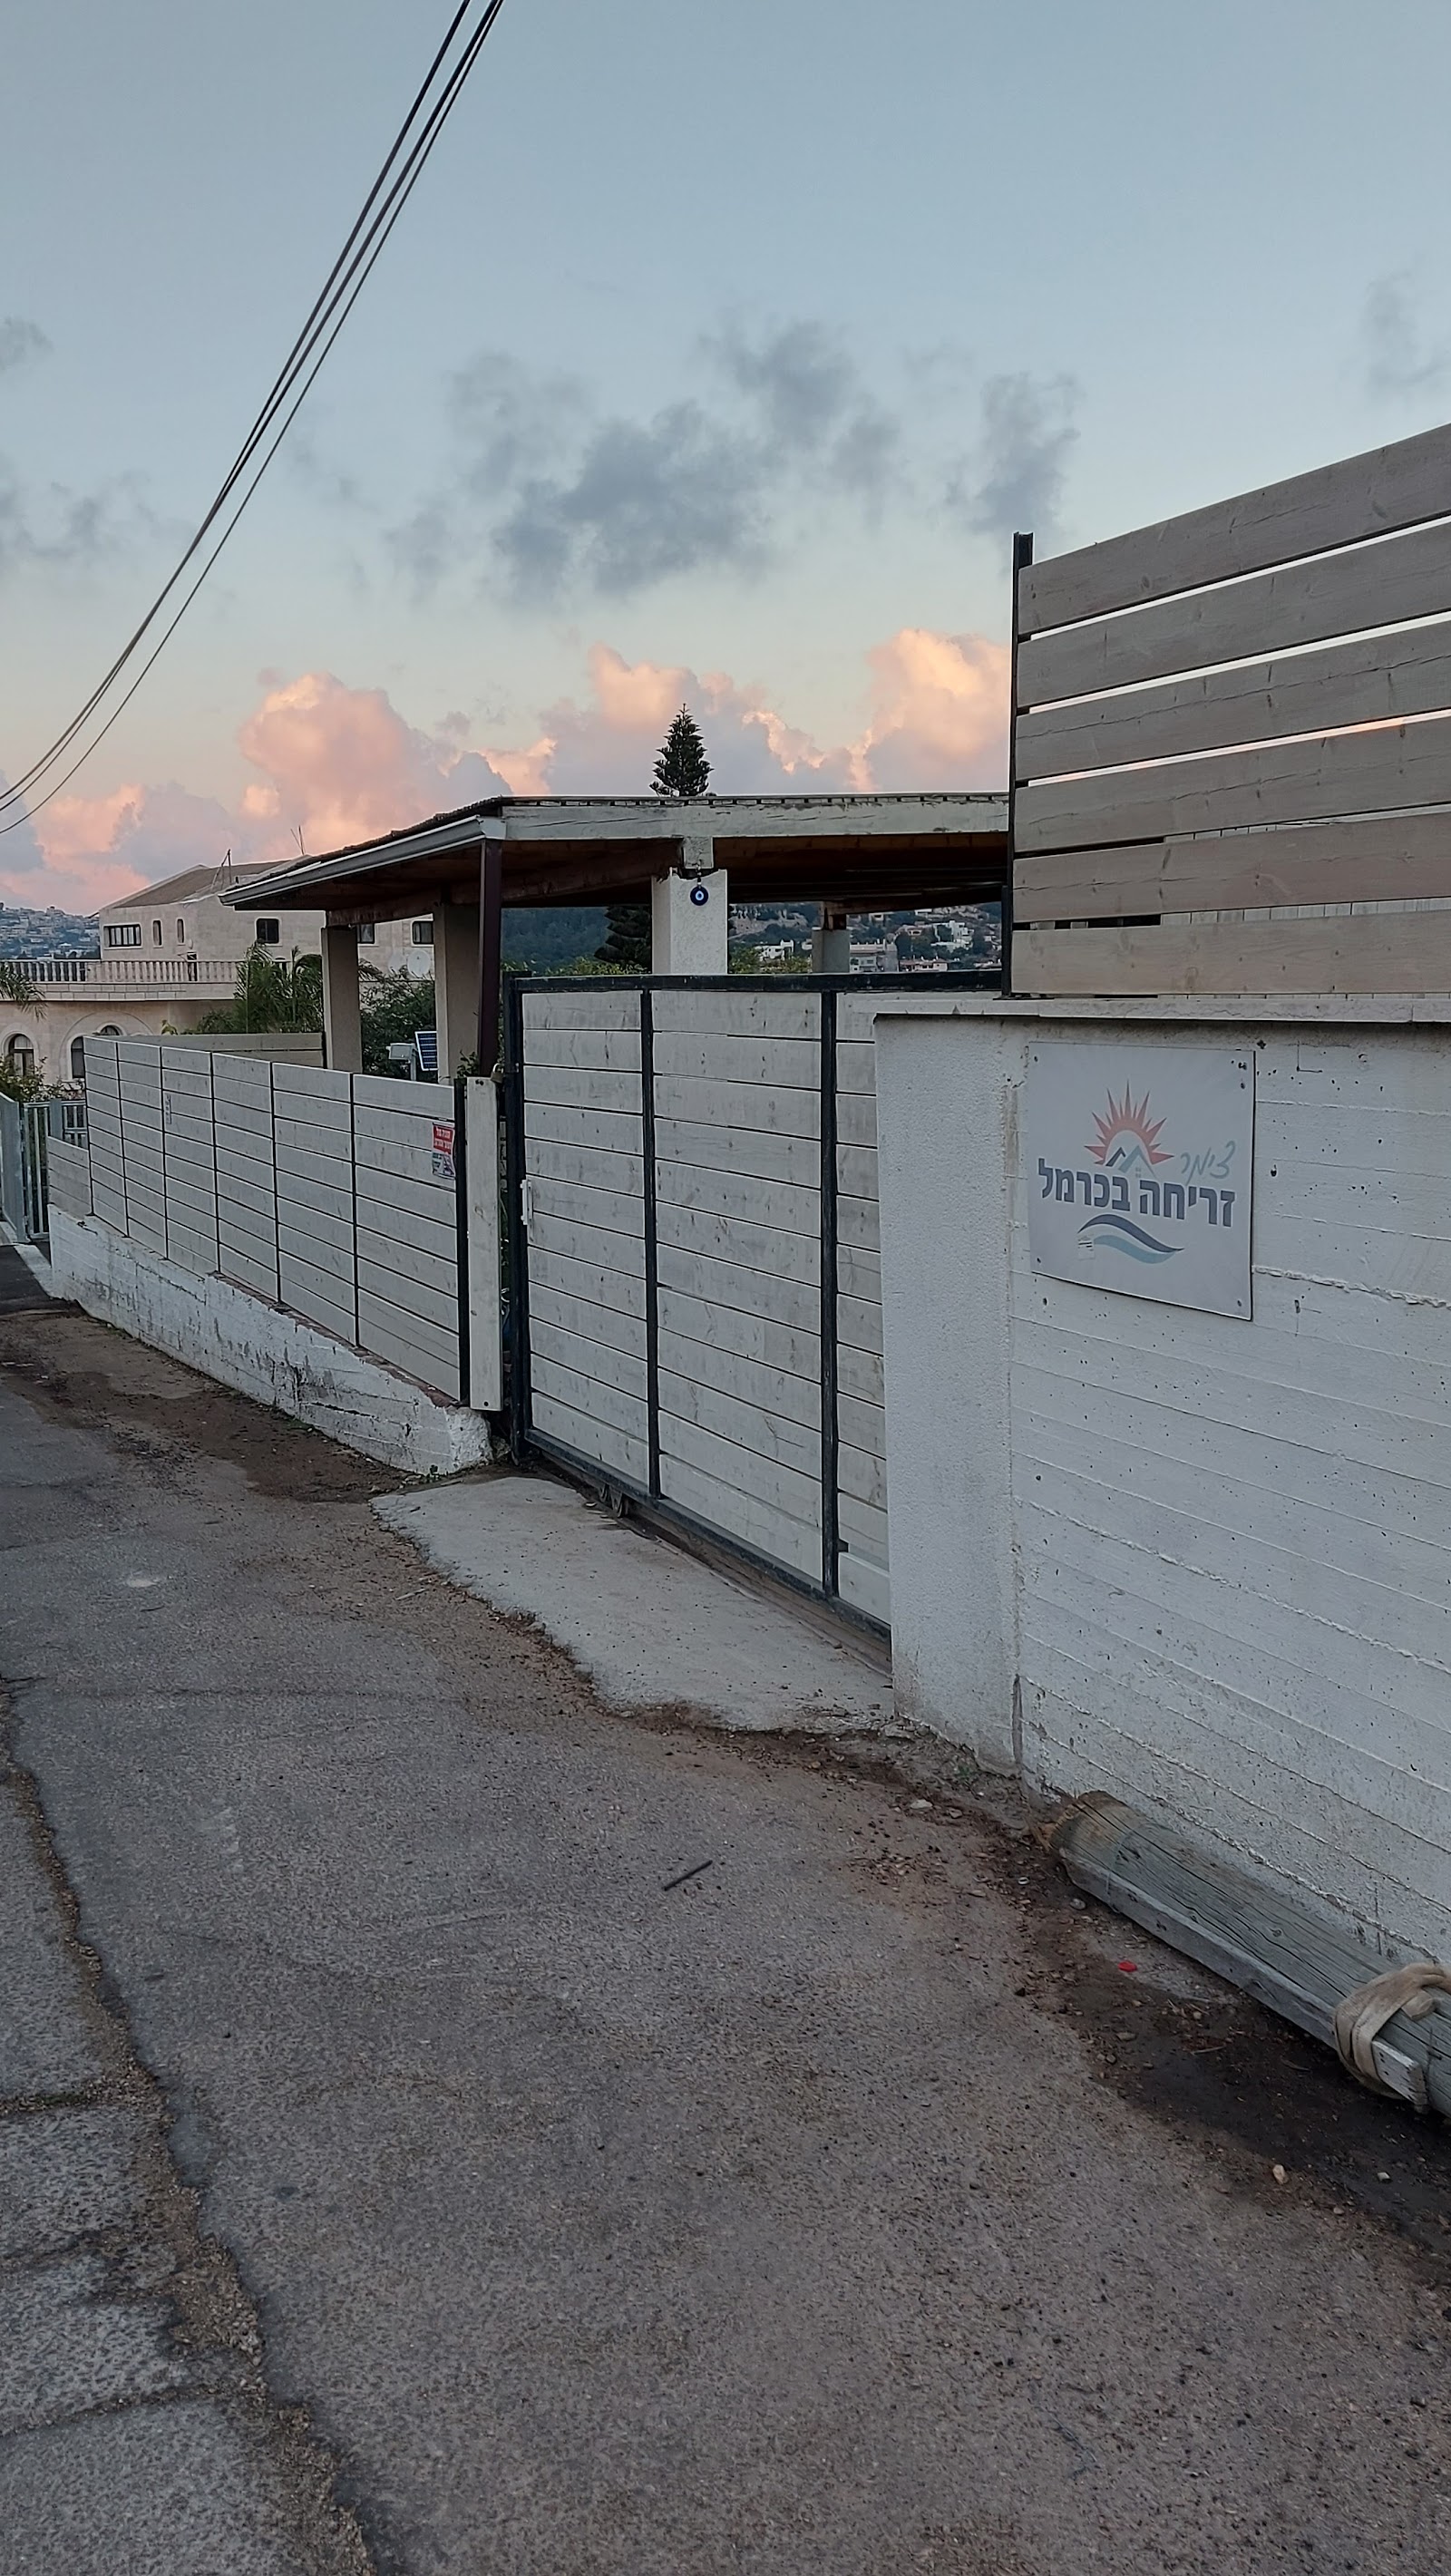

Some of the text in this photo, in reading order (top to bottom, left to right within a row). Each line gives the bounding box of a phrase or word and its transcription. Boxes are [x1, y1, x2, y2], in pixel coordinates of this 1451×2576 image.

[1180, 1140, 1236, 1185] צימר
[1037, 1158, 1236, 1228] זריחה בכרמל
